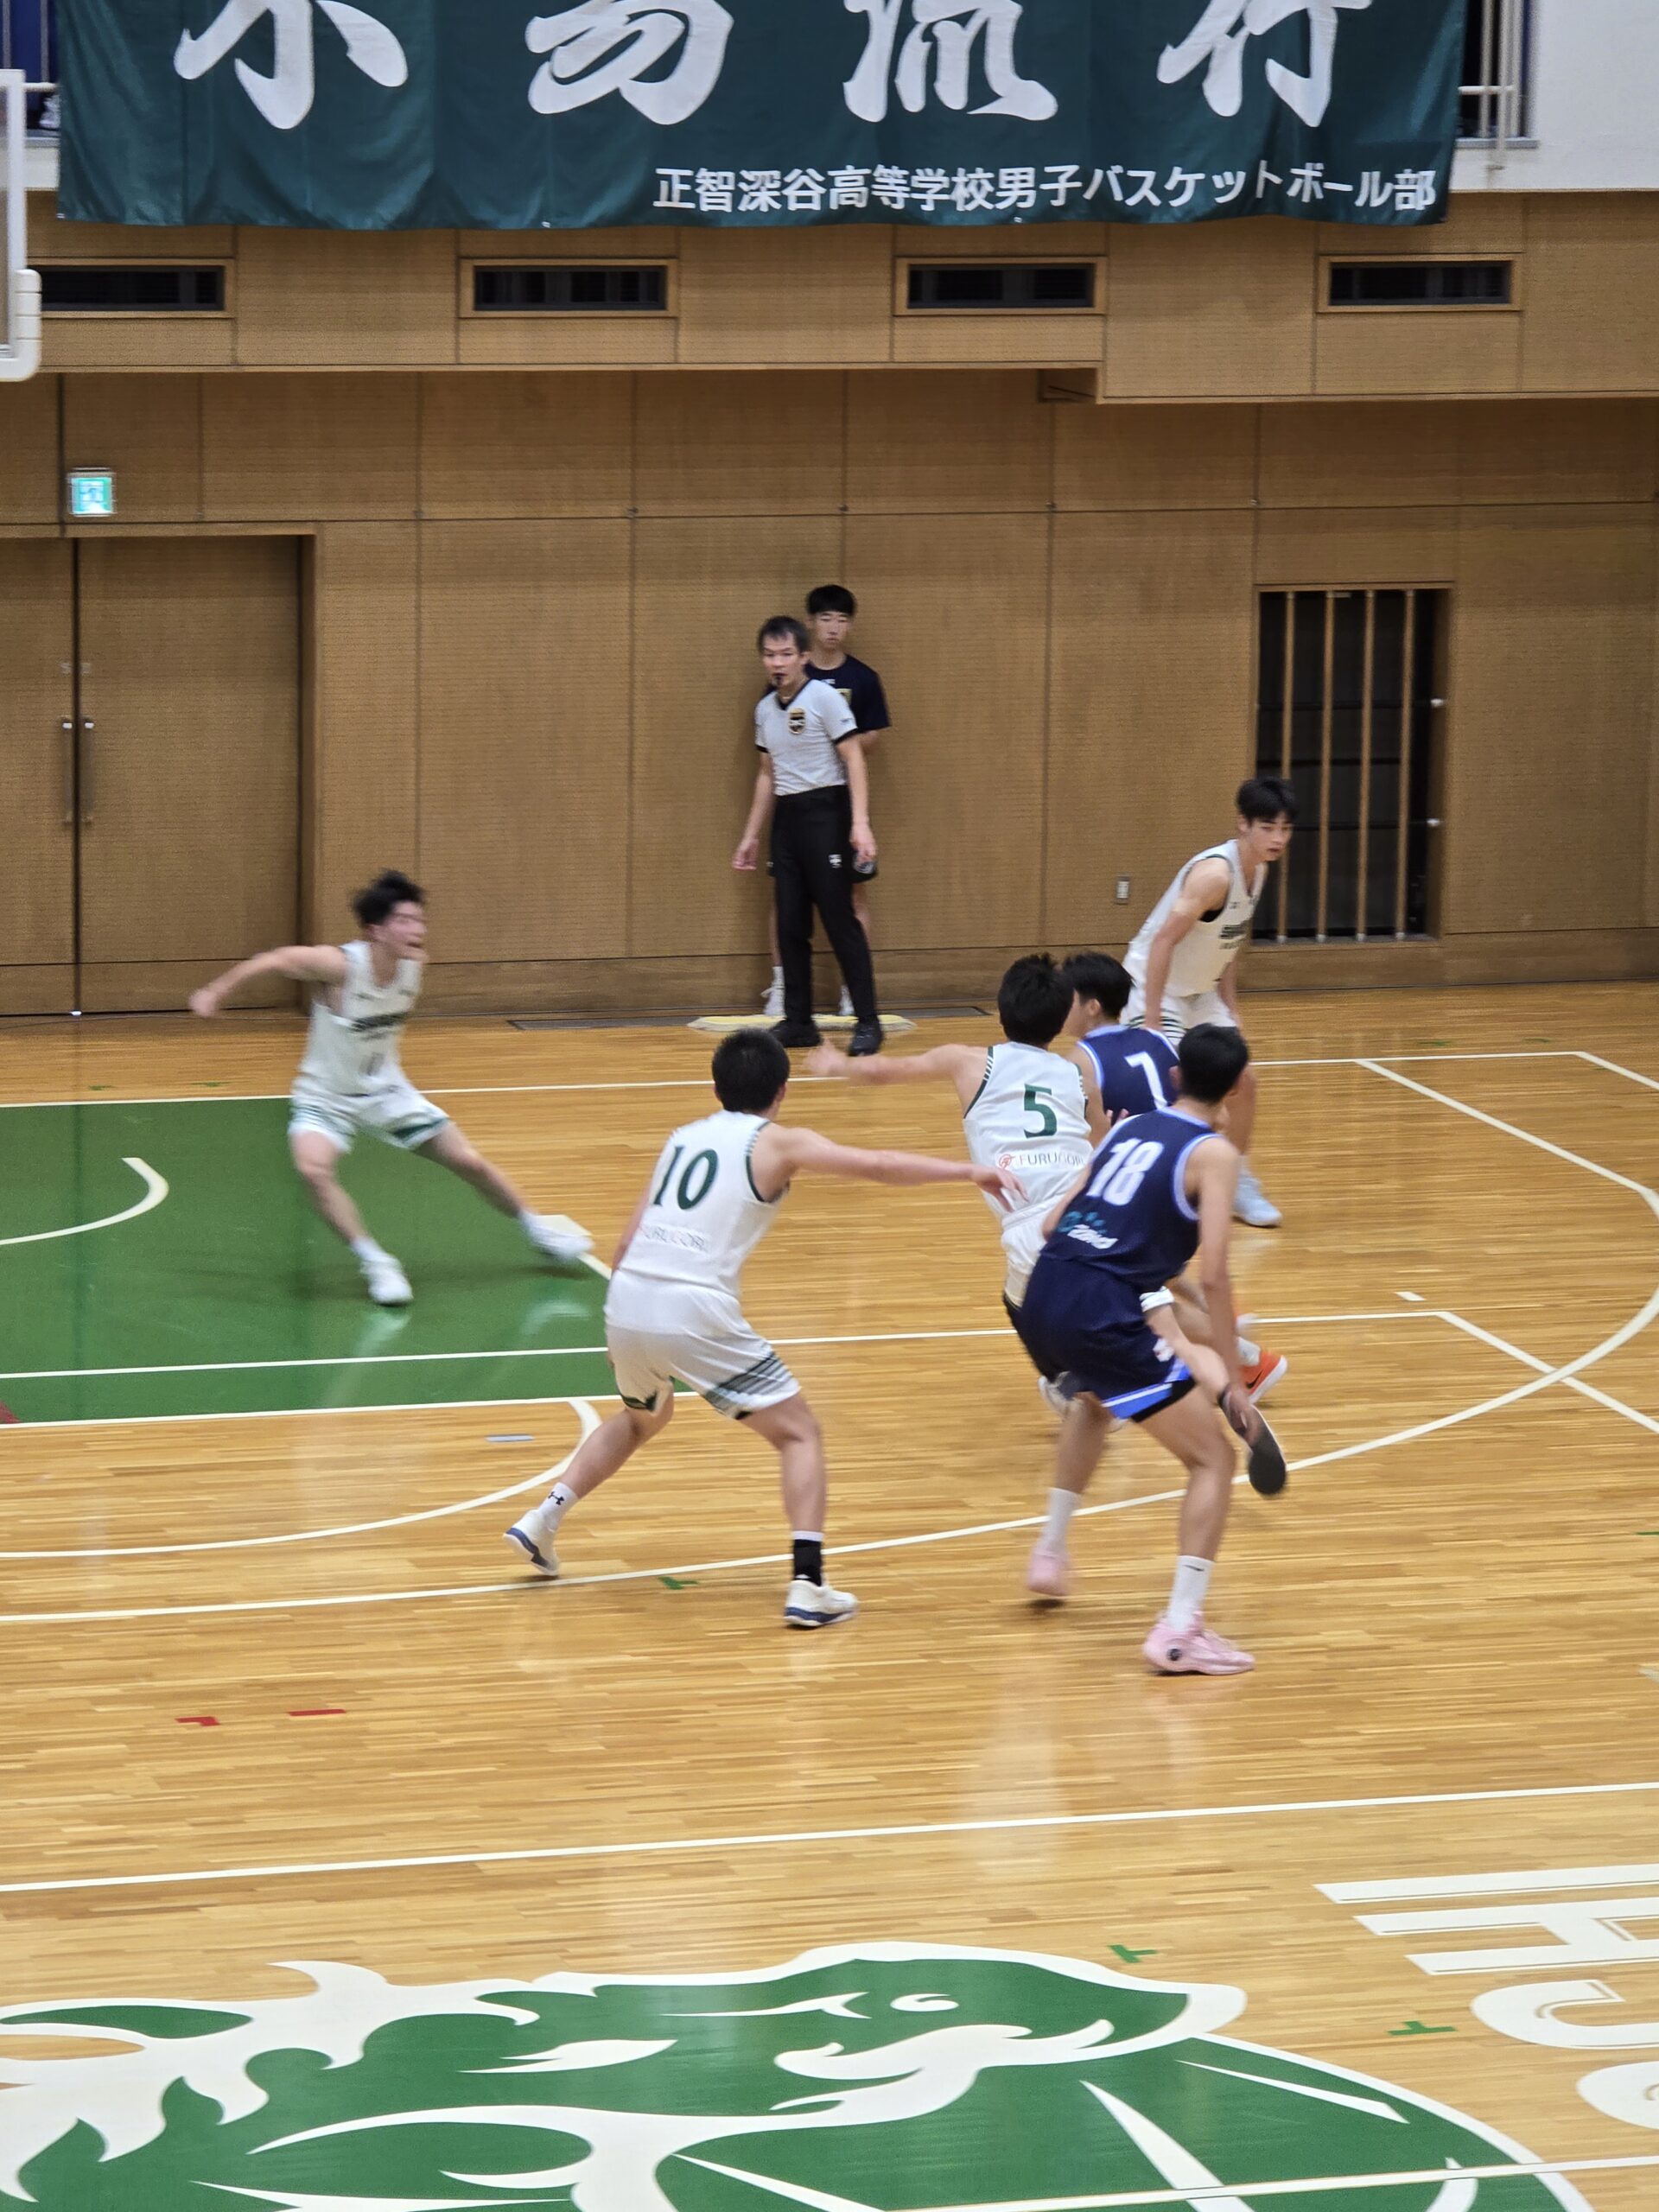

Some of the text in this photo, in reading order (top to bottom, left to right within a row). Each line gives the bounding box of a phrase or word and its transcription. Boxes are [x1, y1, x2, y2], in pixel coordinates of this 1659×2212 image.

[652, 160, 1437, 213] 正智深谷高等学校男子バスケットボール部
[1023, 1084, 1058, 1139] 5
[652, 1145, 719, 1211] 10
[1086, 1137, 1165, 1206] 18
